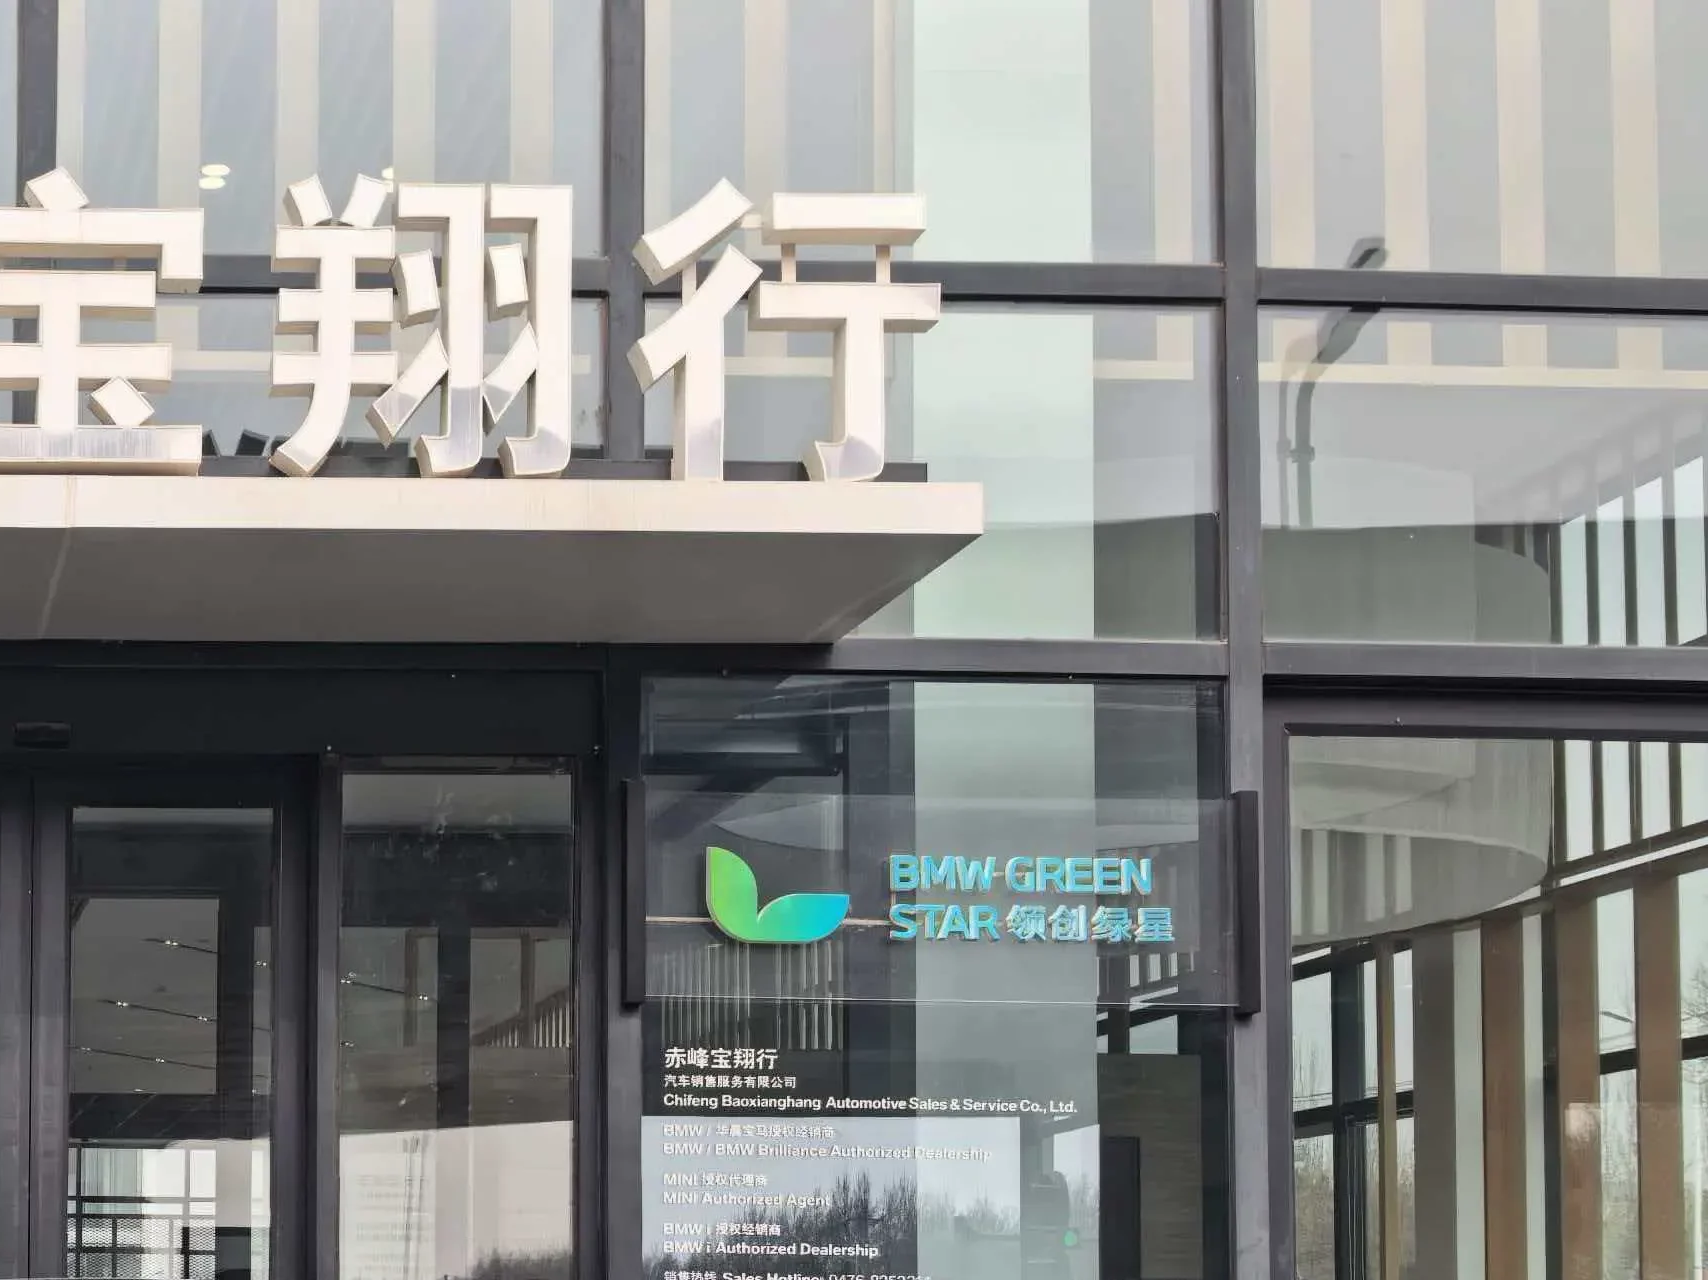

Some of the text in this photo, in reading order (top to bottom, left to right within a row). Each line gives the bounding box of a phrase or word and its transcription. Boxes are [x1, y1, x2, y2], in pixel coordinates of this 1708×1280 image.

[890, 855, 1152, 895] BMW GREEN
[889, 903, 1175, 943] STAR 领创绿星
[664, 1048, 778, 1070] 赤峰宝翔行
[663, 1093, 1078, 1115] Chifeng Baoxianghang Automotive Sales & Service Co., Ltd.
[663, 1124, 702, 1137] BMW
[663, 1143, 702, 1155] BMW
[716, 1144, 755, 1156] BMW
[758, 1144, 827, 1157] Brilliance
[830, 1146, 910, 1159] Authorized
[663, 1173, 698, 1186] MINI
[663, 1192, 831, 1211] MINI Authorized Agent
[663, 1223, 702, 1236] BMW
[663, 1241, 702, 1253] BMW
[716, 1242, 796, 1255] Authorized
[800, 1243, 878, 1259] Dealership
